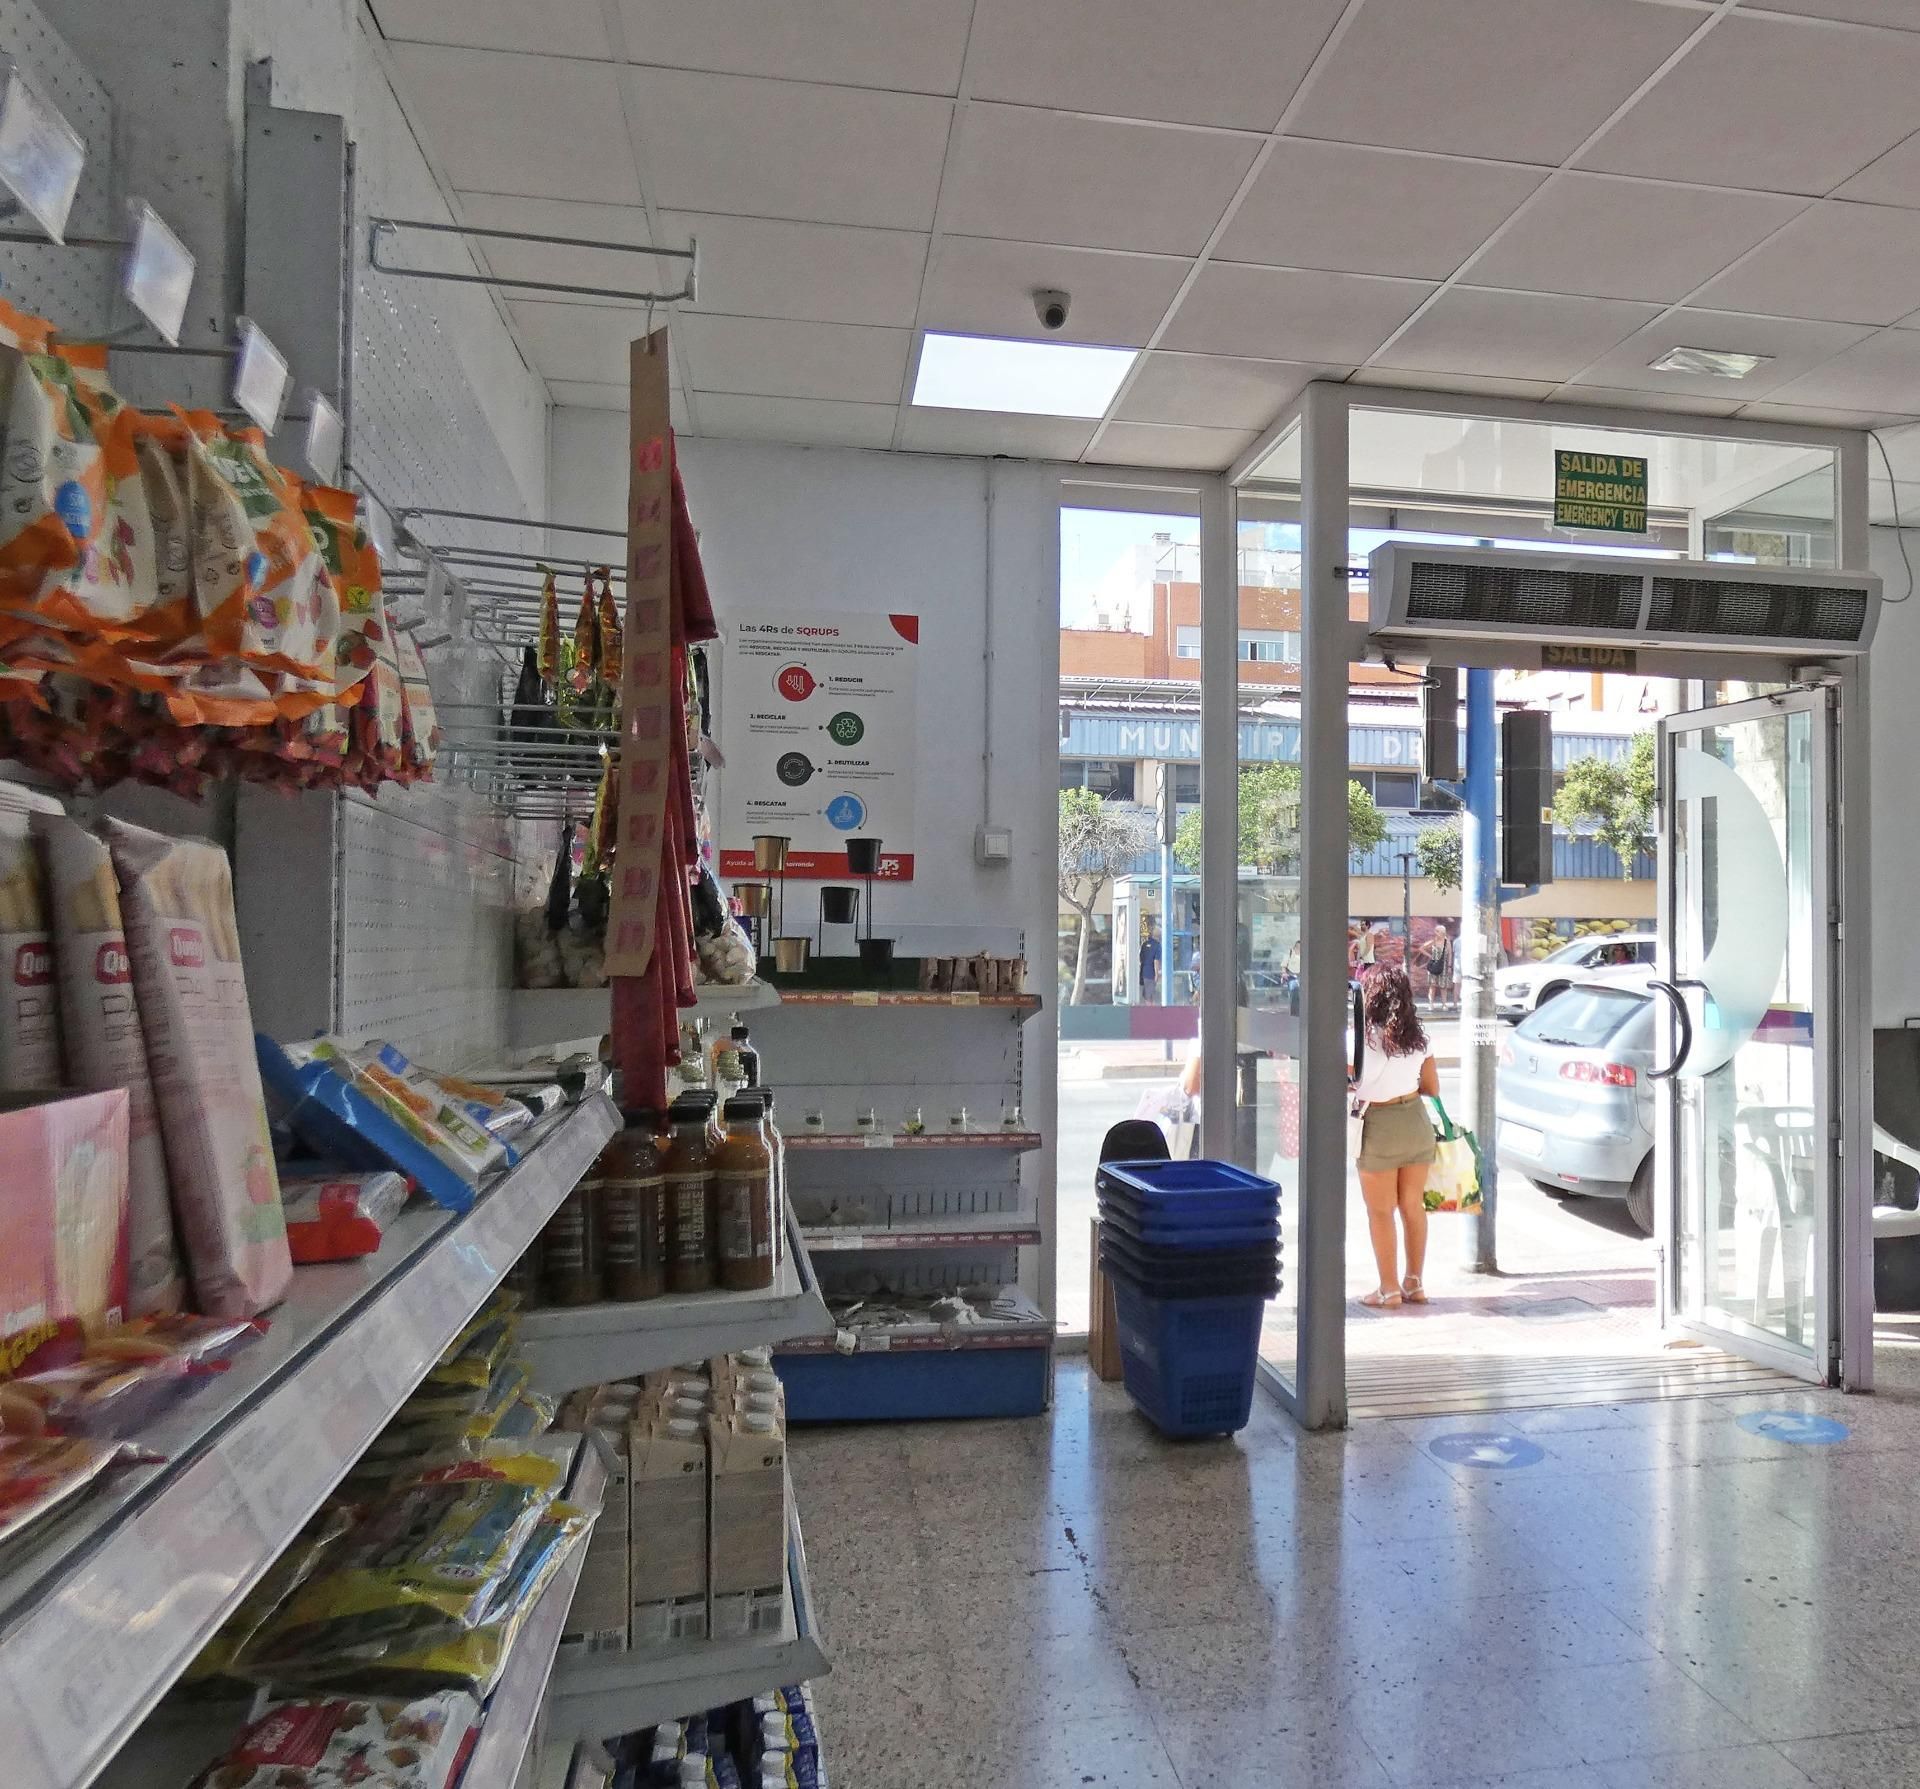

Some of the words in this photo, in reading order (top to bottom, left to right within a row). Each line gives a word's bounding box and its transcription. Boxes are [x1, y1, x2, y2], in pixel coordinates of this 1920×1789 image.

[1560, 453, 1618, 476] SALIDA
[1622, 458, 1643, 478] DE
[1557, 478, 1646, 505] EMERGENCIA
[1557, 503, 1619, 529] EMERGENCY
[1622, 509, 1645, 531] EXIT
[739, 623, 757, 633] Las
[759, 625, 779, 634] 4Rs
[780, 626, 794, 635] de
[796, 627, 840, 637] SQRUPS
[1547, 646, 1626, 666] SALIDA
[834, 676, 863, 684] REDUCIR
[726, 859, 746, 868] Ayuda
